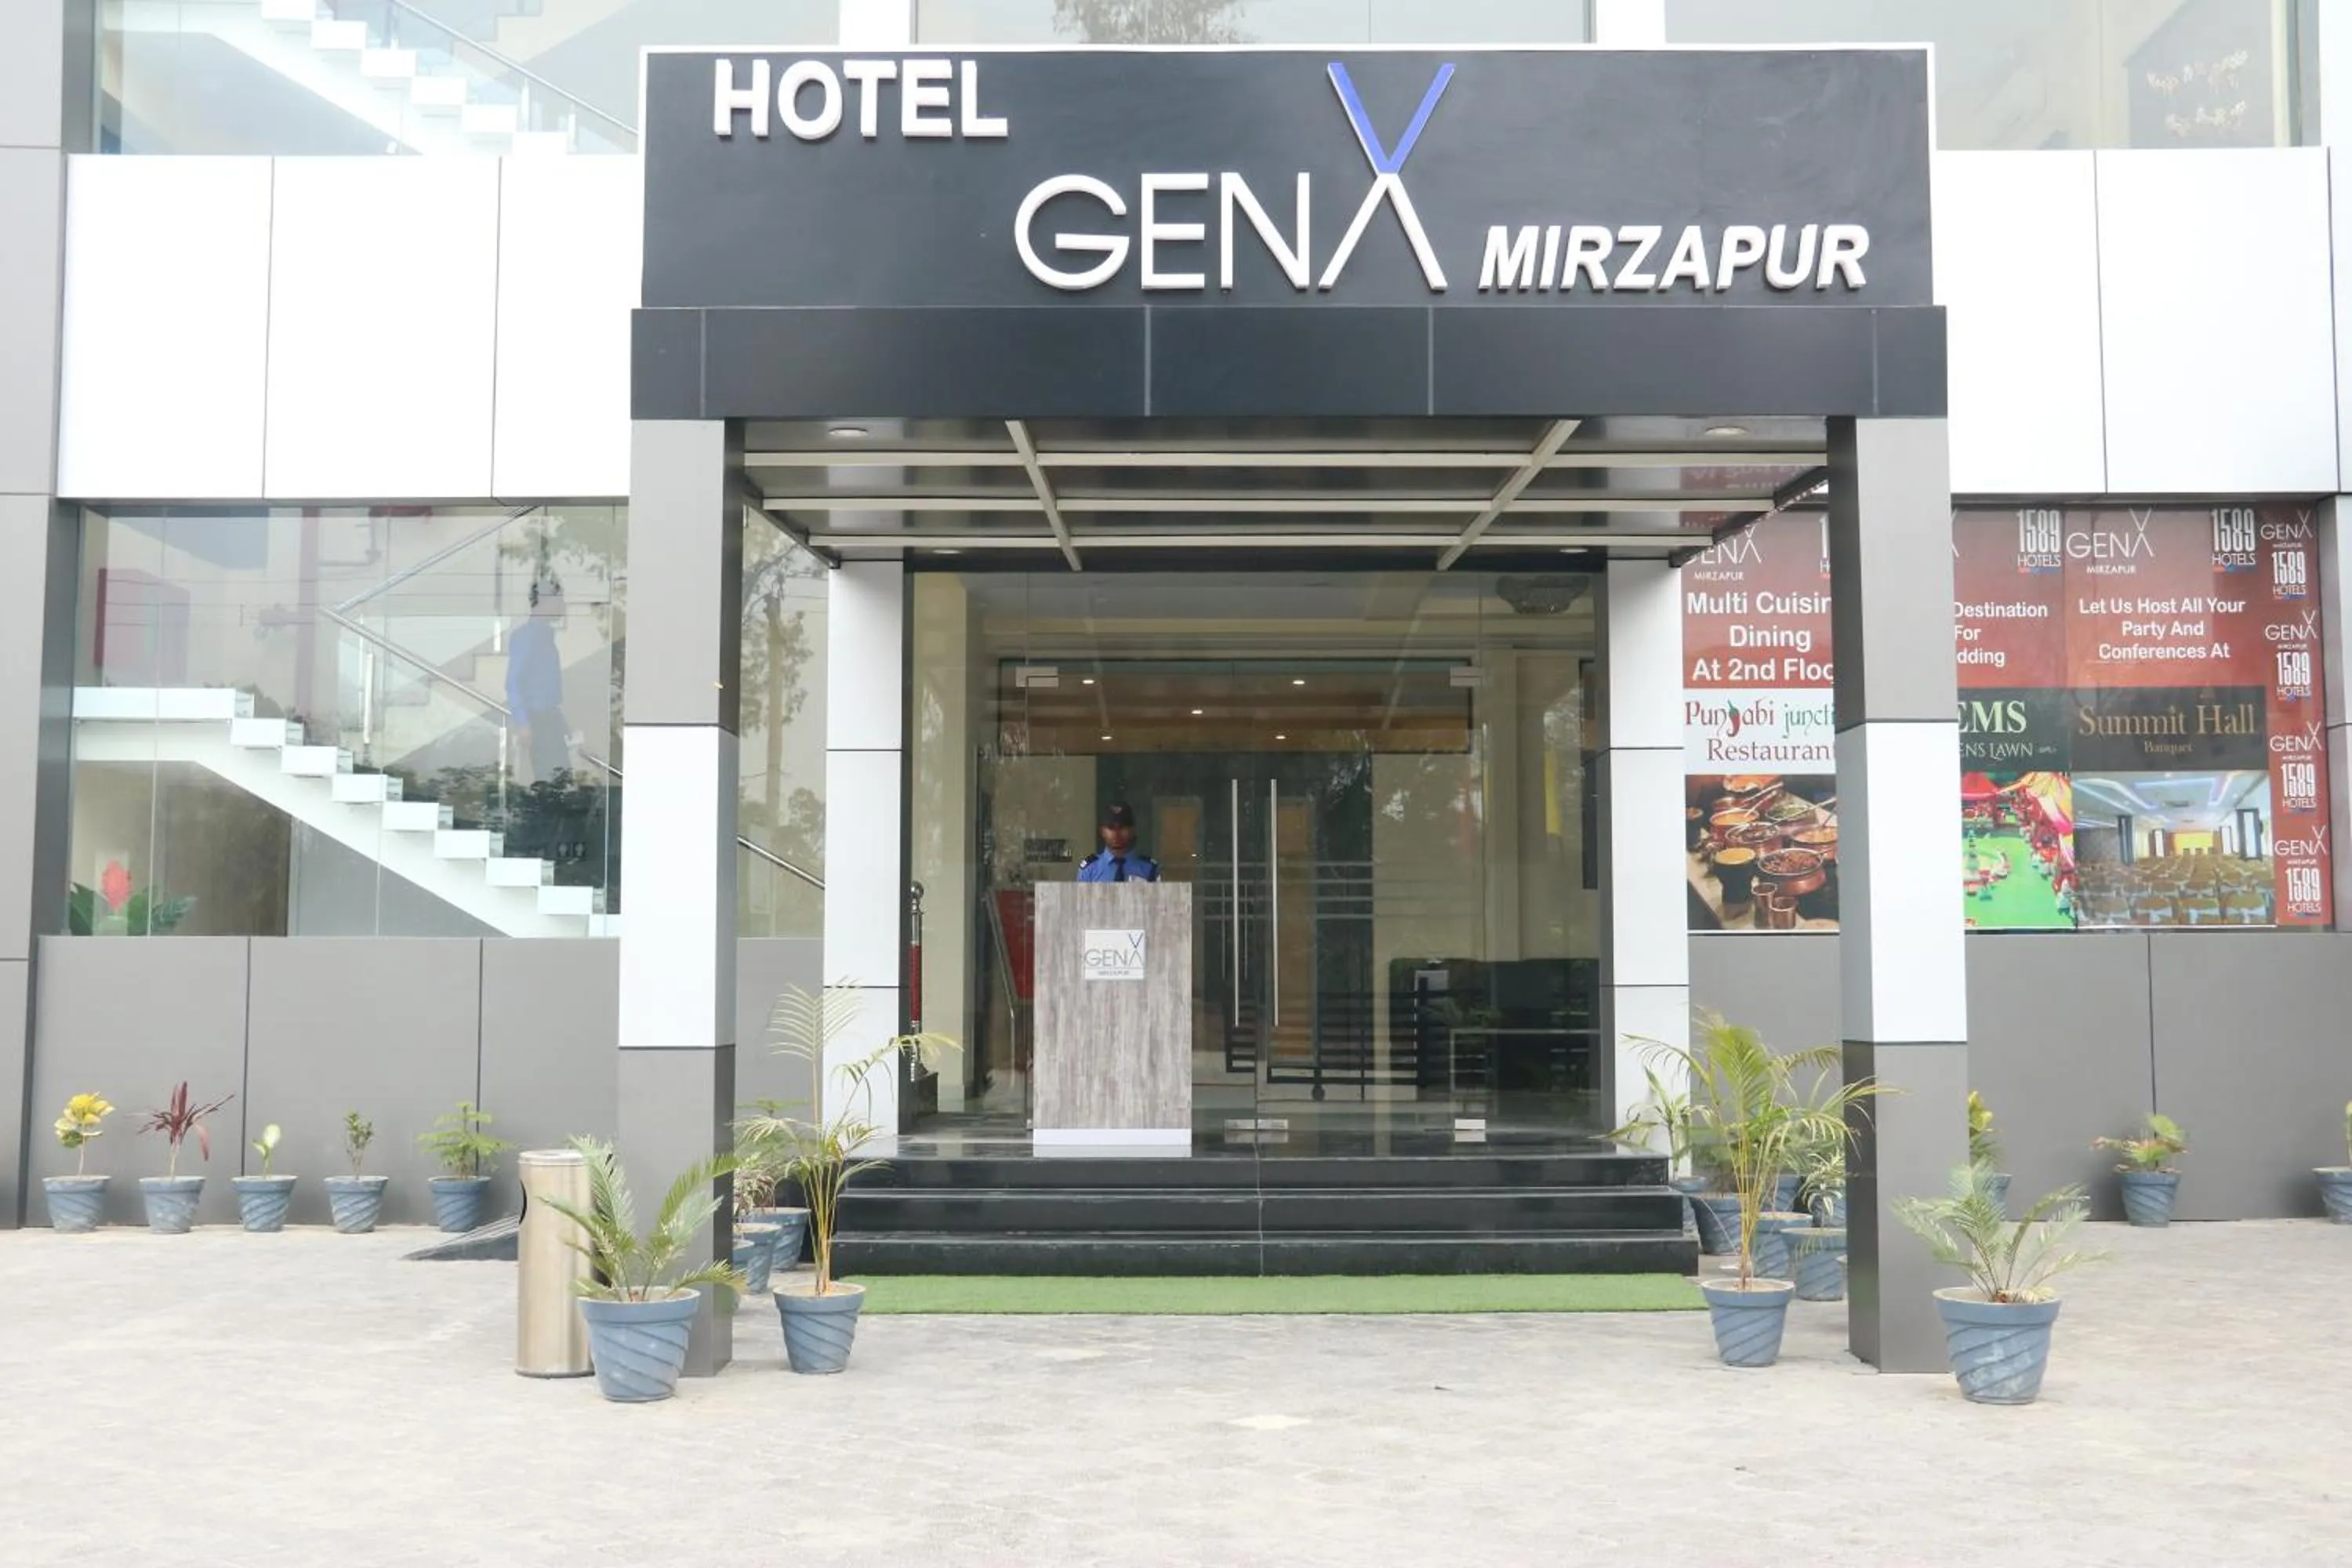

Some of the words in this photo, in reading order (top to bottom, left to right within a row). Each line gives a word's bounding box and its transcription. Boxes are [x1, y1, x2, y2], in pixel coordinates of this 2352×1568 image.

[713, 59, 1009, 140] HOTEL
[1014, 62, 1456, 291] GENX
[1478, 224, 1871, 290] MIRZAPUR
[2016, 510, 2061, 553] 1589
[2066, 508, 2154, 559] GENX
[2211, 508, 2256, 552] 1589
[2260, 509, 2314, 540] GENX
[2018, 553, 2061, 568] HOTELS
[2212, 552, 2256, 566] HOTELS
[2271, 551, 2307, 585] 1589
[1686, 591, 1748, 615] Multi
[1755, 591, 1832, 615] Cuisin
[1955, 601, 2049, 618] Destination
[2078, 598, 2107, 614] Let
[2111, 598, 2133, 614] Us
[2137, 598, 2177, 614] Host
[2181, 597, 2202, 613] All
[2206, 597, 2246, 613] Your
[1730, 625, 1811, 653] Dining
[1955, 625, 1982, 641] For
[2122, 621, 2167, 640] Party
[2170, 621, 2205, 636] And
[2264, 609, 2318, 641] GENX
[2098, 643, 2206, 659] Conferences
[2211, 643, 2231, 659] At
[1692, 658, 1723, 681] At
[1728, 658, 1776, 681] 2nd
[1784, 658, 1834, 682] Floo
[2276, 652, 2310, 686] 1589
[1958, 700, 2027, 734] EMS
[2079, 705, 2188, 736] Summit
[2196, 703, 2256, 735] Hall
[1706, 739, 1831, 762] Restauran
[1989, 742, 2034, 761] LAWN
[2270, 720, 2324, 752] GENX
[2281, 763, 2317, 798] 1589
[2283, 798, 2318, 808] HOTELS
[2274, 825, 2328, 856] GENX
[2285, 867, 2321, 902] 1589
[1084, 932, 1145, 967] GENX
